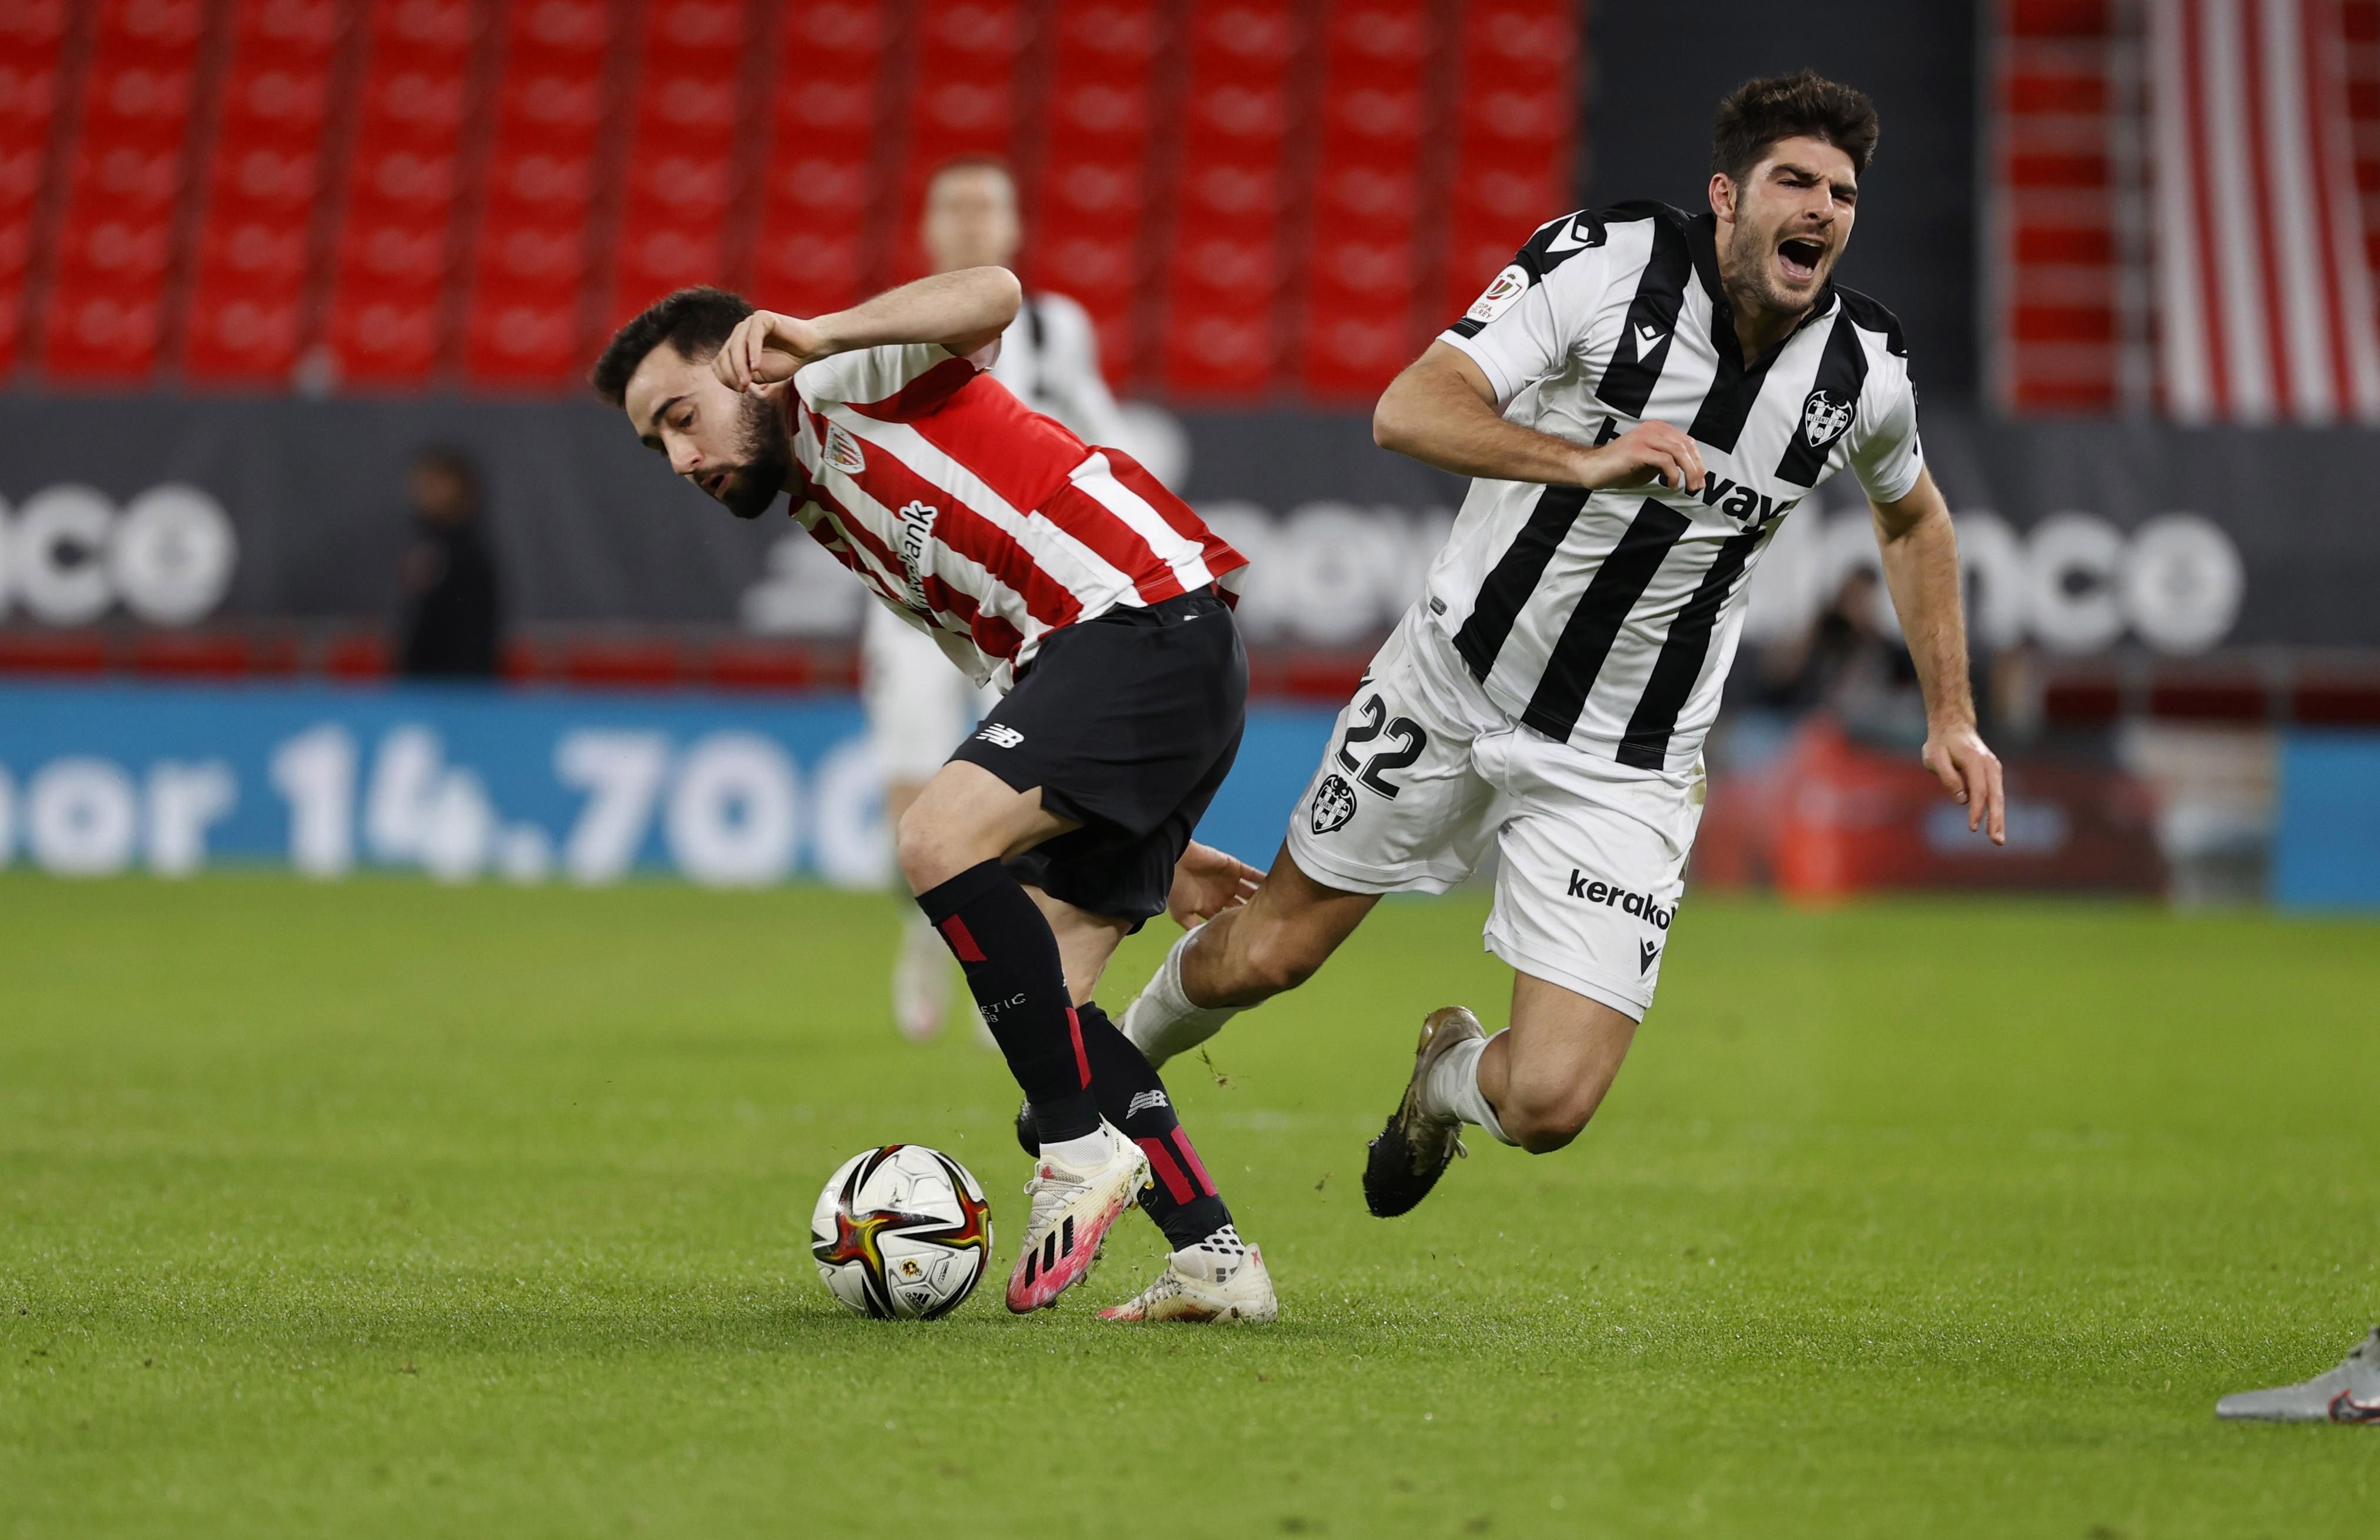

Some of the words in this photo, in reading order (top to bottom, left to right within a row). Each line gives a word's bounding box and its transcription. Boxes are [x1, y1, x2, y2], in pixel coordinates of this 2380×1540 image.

[1809, 415, 1830, 424] LEVANTE
[0, 484, 236, 625] co
[1335, 694, 1426, 801] 22
[0, 755, 240, 876] or
[1319, 798, 1333, 811] LEVANTE
[905, 1292, 924, 1309] adidas
